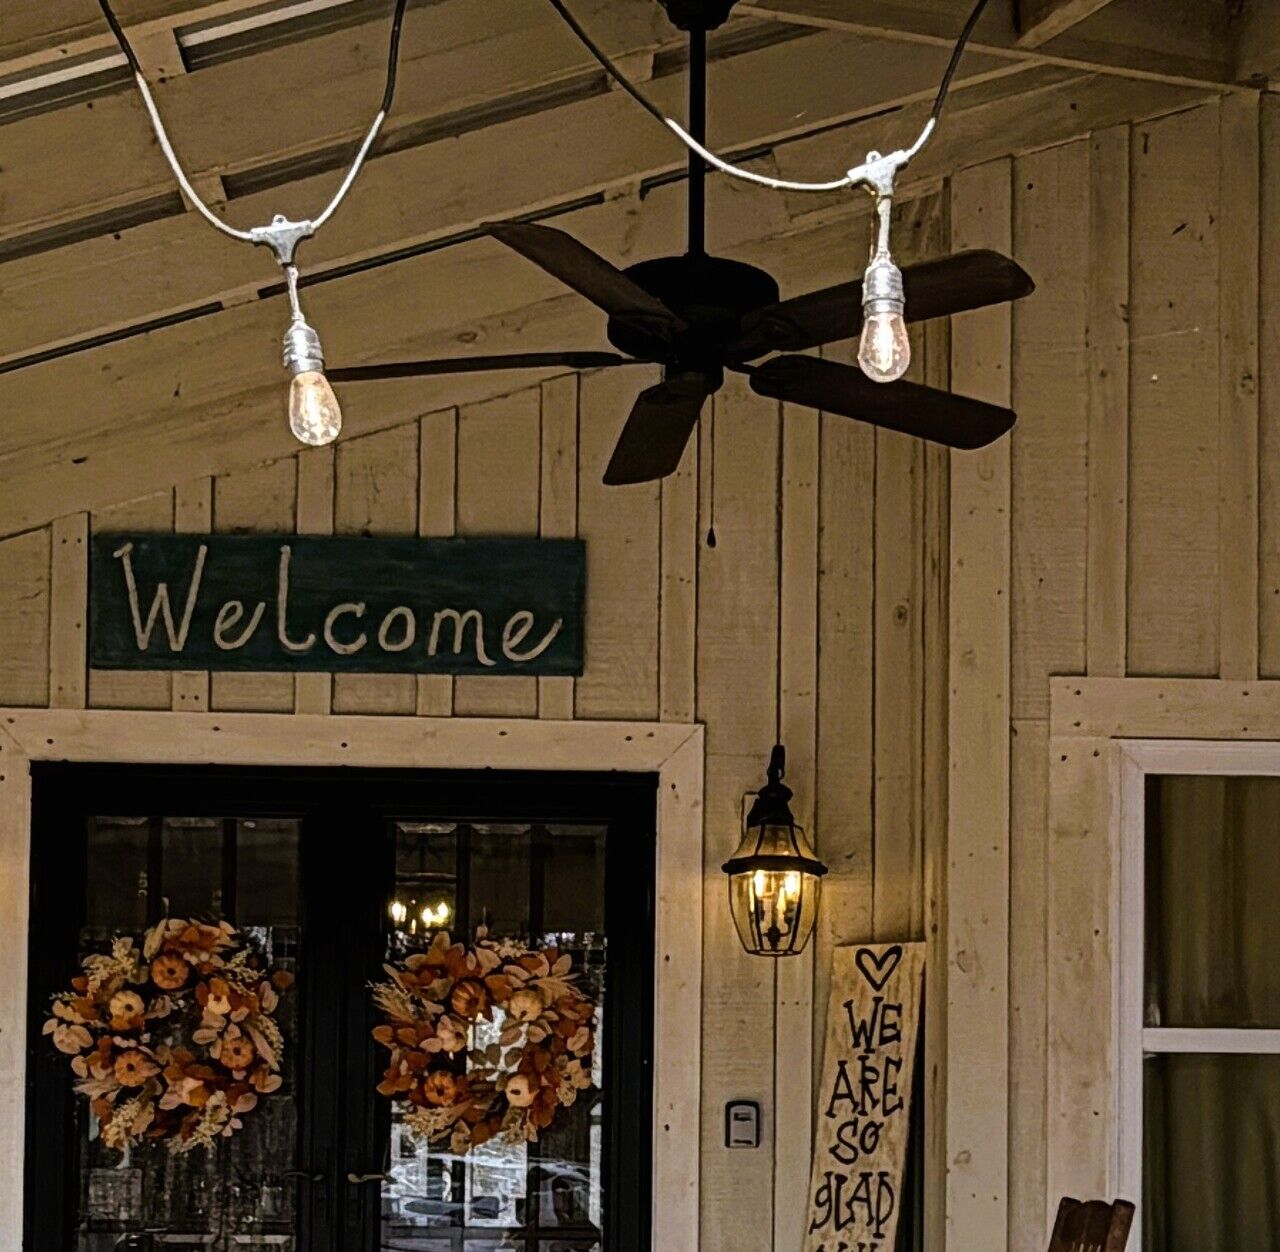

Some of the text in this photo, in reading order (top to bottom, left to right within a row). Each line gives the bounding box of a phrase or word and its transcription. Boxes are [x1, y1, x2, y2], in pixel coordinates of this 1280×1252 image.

[113, 543, 562, 666] Welcome
[843, 997, 902, 1053] WE
[825, 1055, 903, 1118] ARE
[829, 1117, 884, 1164] SO
